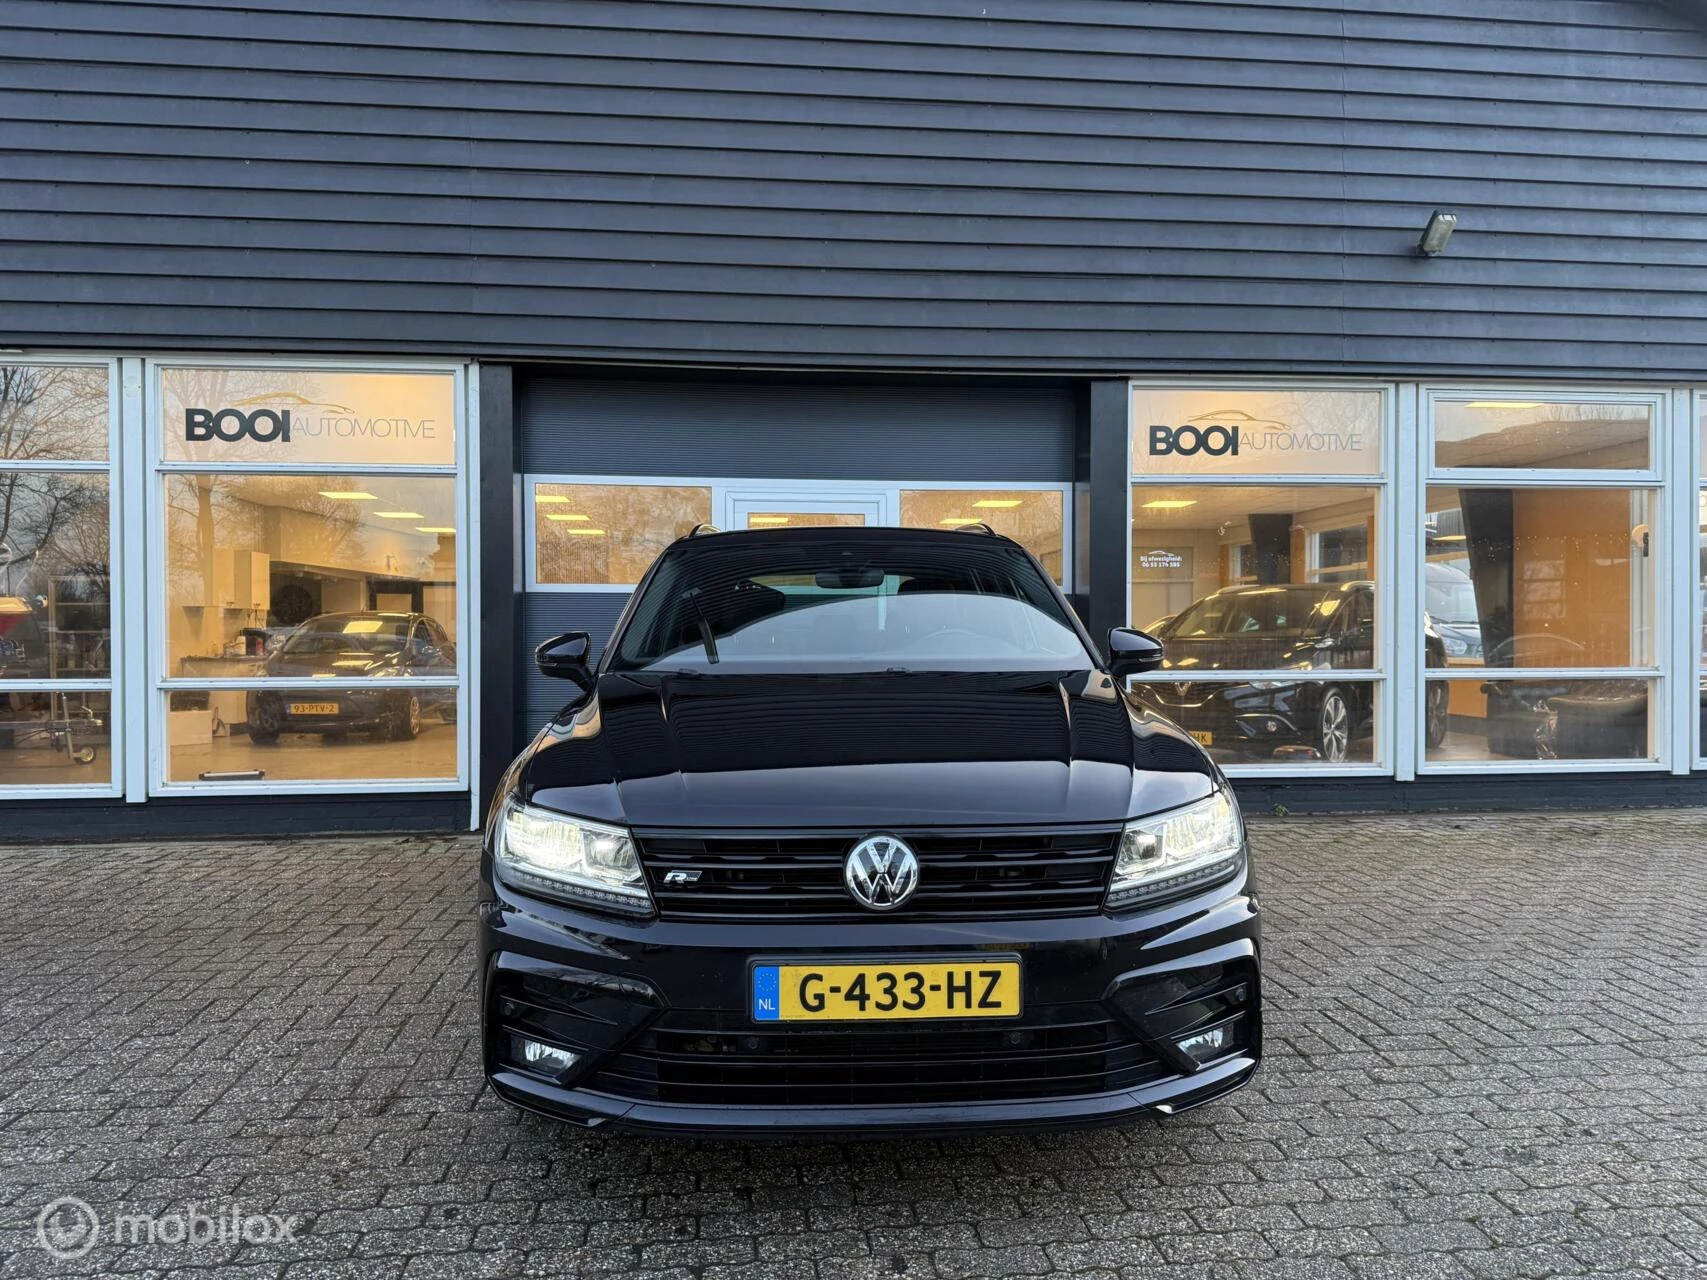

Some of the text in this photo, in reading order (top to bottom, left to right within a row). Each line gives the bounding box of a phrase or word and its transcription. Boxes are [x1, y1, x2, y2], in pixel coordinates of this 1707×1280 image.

[185, 408, 436, 442] BOOI AUTOMOTIVE
[1149, 425, 1363, 456] BOOI AUTOMOTIVE
[294, 704, 335, 713] 93-PTV-2
[758, 998, 776, 1011] NL
[798, 970, 1002, 1013] G-433-HZ
